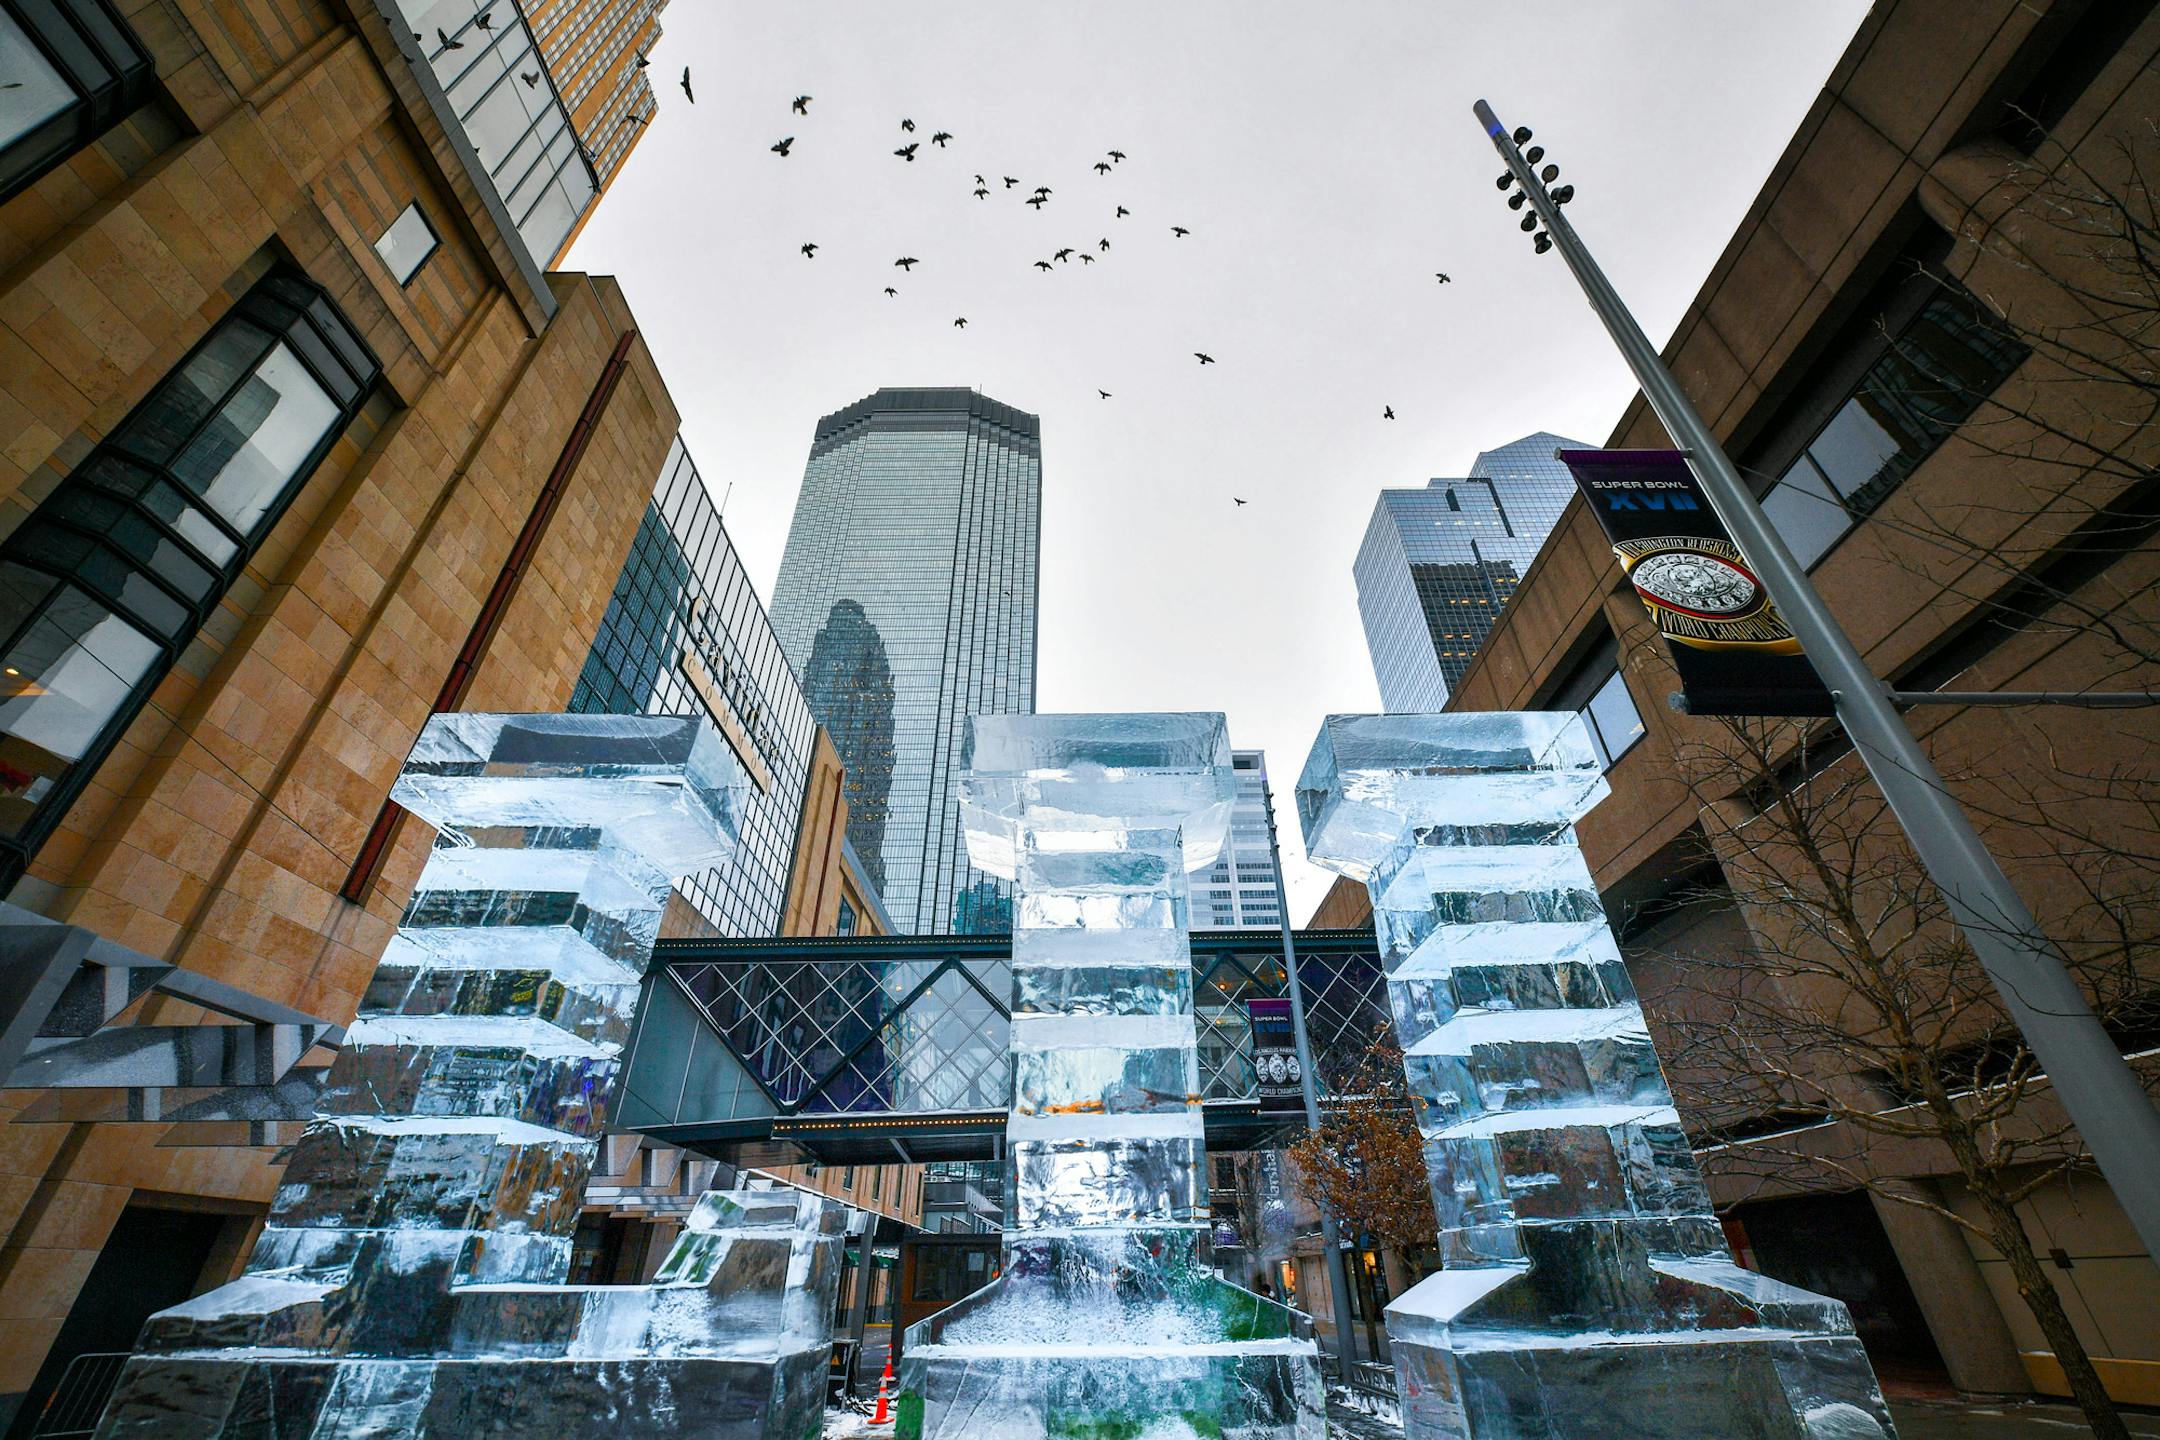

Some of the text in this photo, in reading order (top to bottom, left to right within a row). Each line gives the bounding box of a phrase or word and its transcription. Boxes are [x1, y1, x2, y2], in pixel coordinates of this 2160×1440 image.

[1592, 481, 1689, 489] SUPER BOWL
[1602, 492, 1700, 511] XVII
[1619, 537, 1738, 561] WASHINGTON REDSKINS
[1660, 609, 1790, 641] WORLD CHAMPIONS
[687, 658, 770, 788] COMMON
